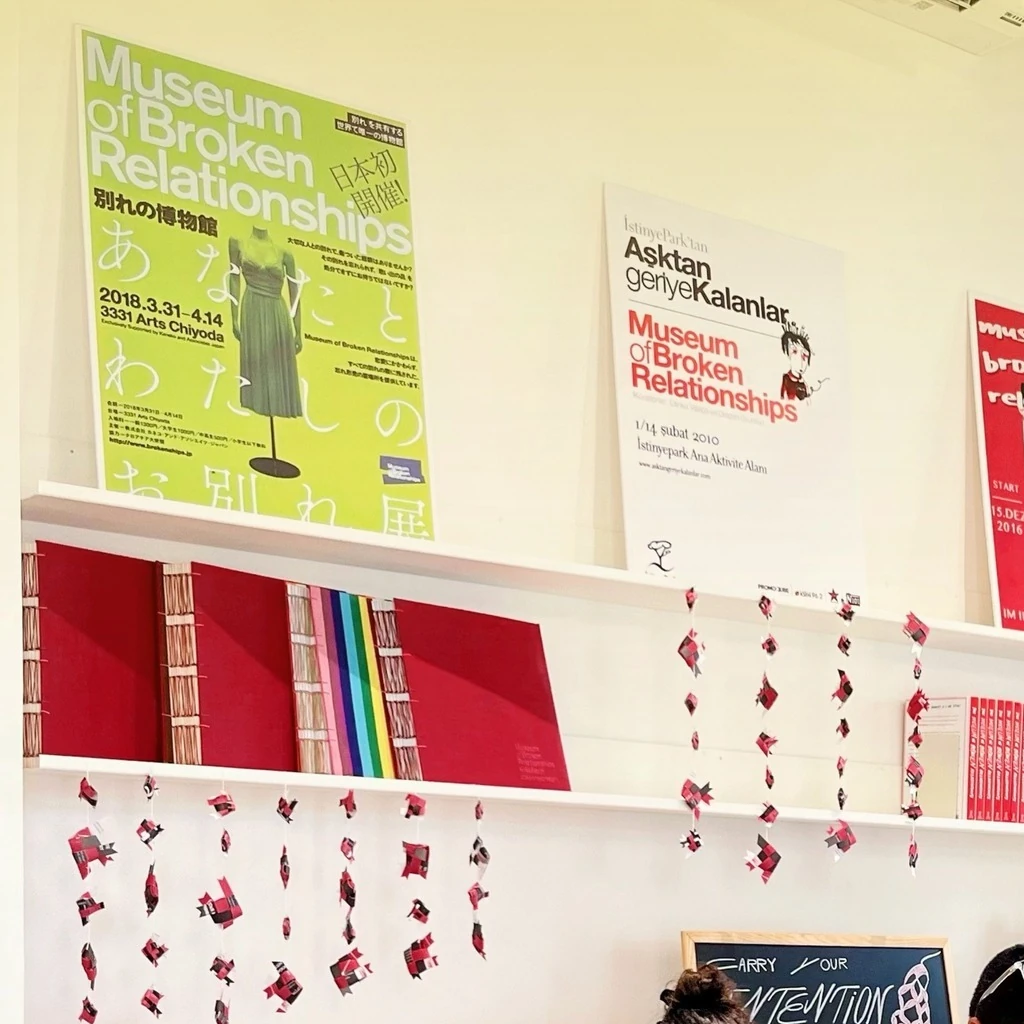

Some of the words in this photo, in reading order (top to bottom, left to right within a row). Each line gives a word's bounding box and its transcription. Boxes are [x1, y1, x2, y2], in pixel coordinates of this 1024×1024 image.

[86, 36, 302, 140] Museum
[87, 94, 133, 138] of
[139, 97, 314, 187] Broken
[329, 150, 397, 192] 日本初
[91, 132, 412, 255] Relationships
[94, 187, 218, 238] 別れの博物館
[624, 236, 712, 280] Aşktan
[101, 305, 132, 322] 3331
[136, 313, 166, 330] Arts
[169, 320, 224, 343] Chiyoda
[628, 310, 739, 360] Museum
[629, 340, 652, 364] of
[653, 344, 743, 385] Broken
[632, 362, 798, 423] Relationships
[635, 420, 657, 436] 1/14
[693, 432, 720, 445] 2010
[691, 450, 709, 463] Ana
[710, 453, 743, 470] Aktivite
[993, 480, 1019, 493] START
[997, 521, 1023, 536] 2016
[1003, 608, 1016, 620] IM
[790, 957, 848, 975] YOUR
